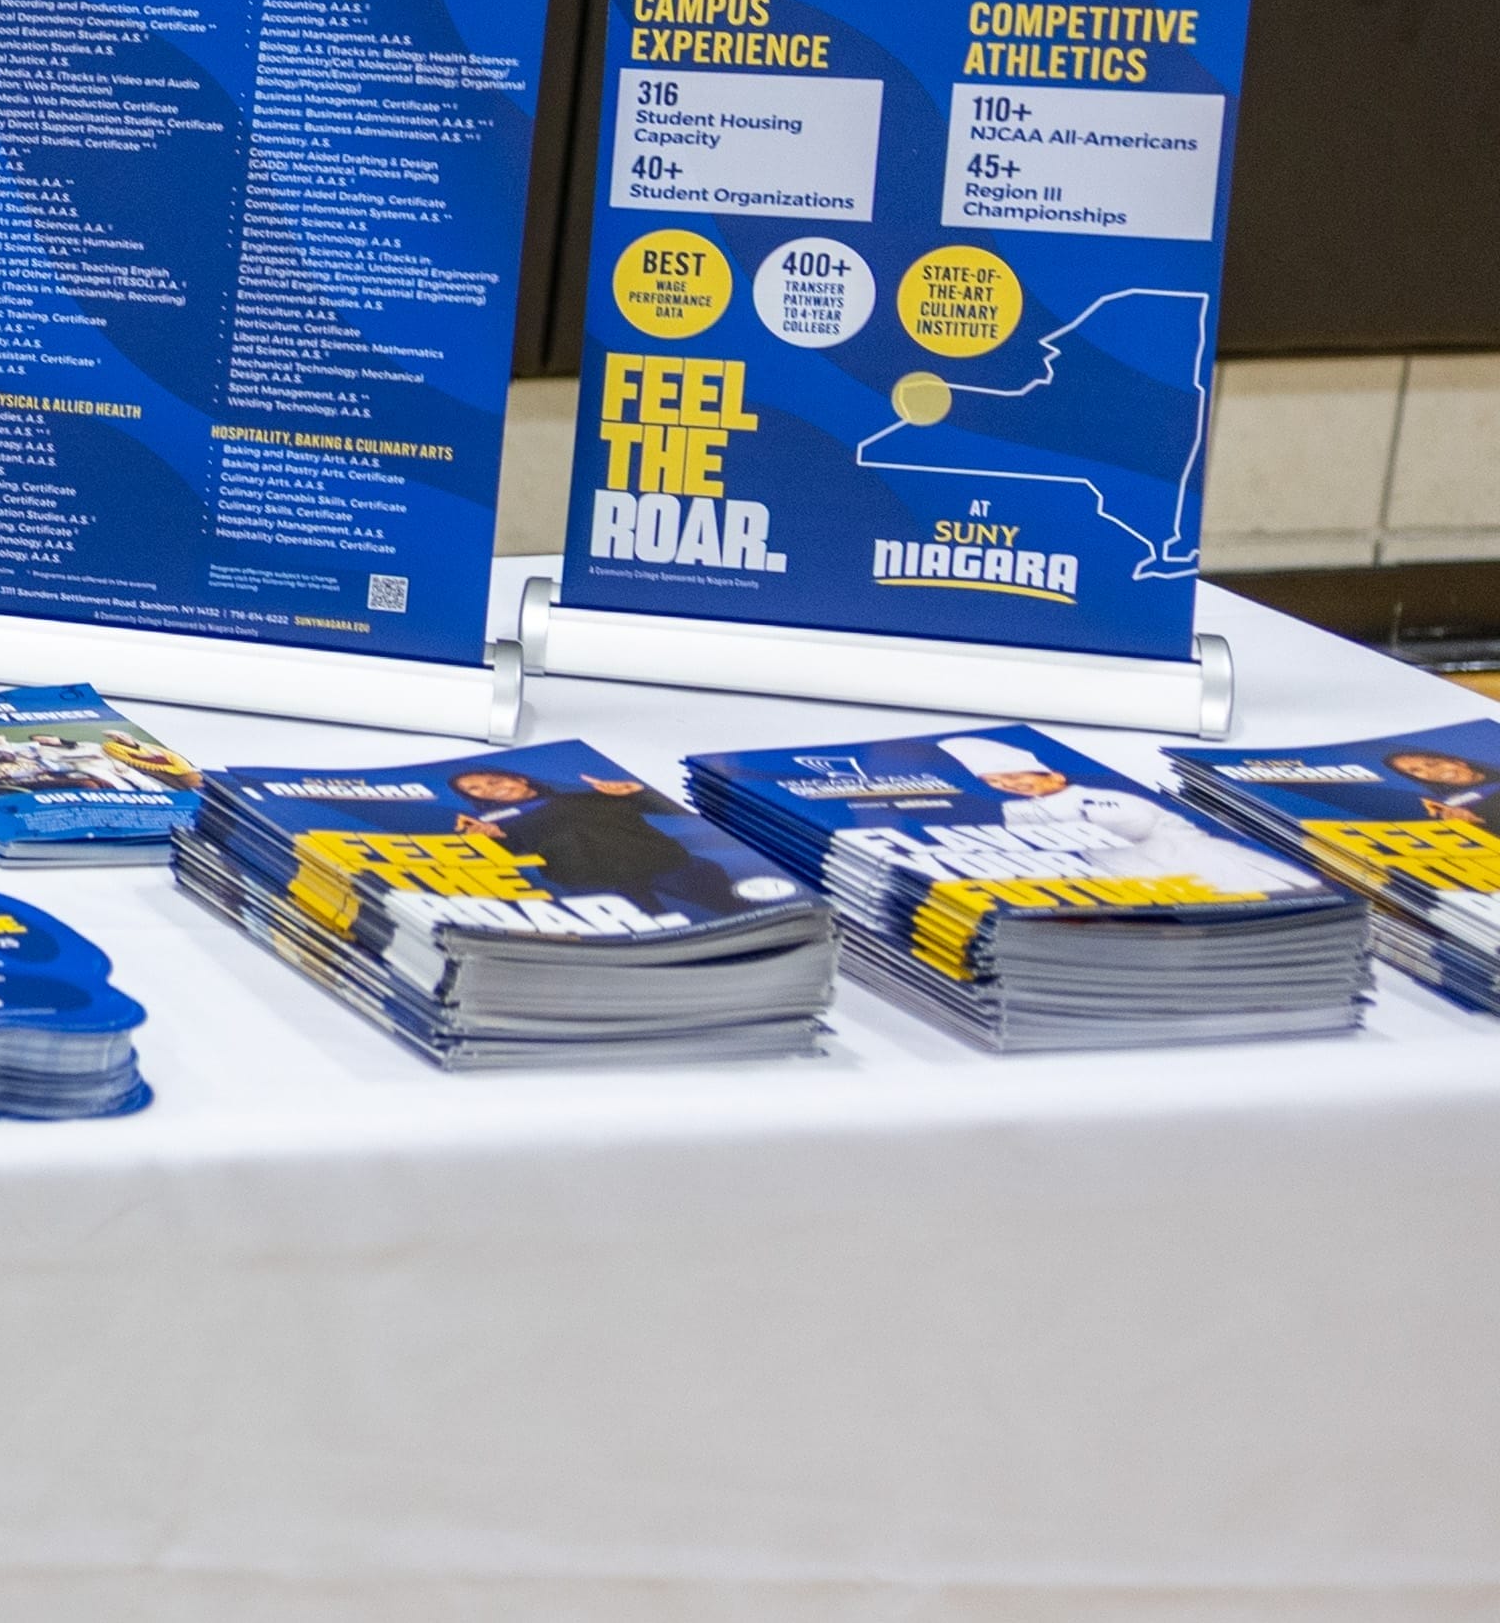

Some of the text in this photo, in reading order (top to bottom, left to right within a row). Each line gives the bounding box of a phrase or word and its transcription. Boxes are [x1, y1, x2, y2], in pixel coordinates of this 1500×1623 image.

[968, 1, 1199, 45] COMPETITIVE
[631, 27, 831, 69] EXPERIENCE
[963, 41, 1148, 83] ATHLETICS
[637, 80, 679, 107] 316
[635, 109, 803, 135] Student Housing
[973, 96, 1032, 123] 110+
[633, 127, 721, 150] Capacity
[970, 125, 1198, 151] NJCAA All-Americans
[631, 155, 683, 181] 40+
[966, 153, 1021, 179] 45+
[629, 182, 855, 210] Student Organizations
[965, 182, 1062, 202] Region III
[962, 201, 1127, 227] Championships
[642, 249, 706, 277] BEST
[781, 251, 851, 278] 400+
[922, 264, 1001, 284] STATE-OF-
[628, 291, 711, 307] PERFORMANCE
[656, 280, 686, 293] WAGE
[785, 280, 845, 295] TRANSFER
[928, 283, 993, 302] THE-ART
[655, 305, 684, 319] DATA
[783, 293, 844, 308] PATHWAYS
[920, 301, 998, 320] CULINARY
[782, 319, 840, 336] COLLEGES
[783, 307, 842, 323] TO 4-YEAR
[916, 319, 998, 339] INSTITUTE
[601, 352, 759, 431] FEEL
[41, 397, 52, 411] &
[52, 398, 94, 415] ALLIED
[95, 402, 142, 419] HEALTH
[210, 425, 453, 461] HOSPITALITY, BAKING & CULINARY ARTS
[599, 420, 729, 499] THE
[969, 499, 991, 518] AT
[590, 489, 788, 573] ROAR.
[934, 520, 1020, 548] SUNY
[872, 539, 1079, 595] NIAGARA
[33, 794, 174, 806] OUR MISSION
[304, 830, 548, 868] FEEL
[358, 864, 554, 902] THE
